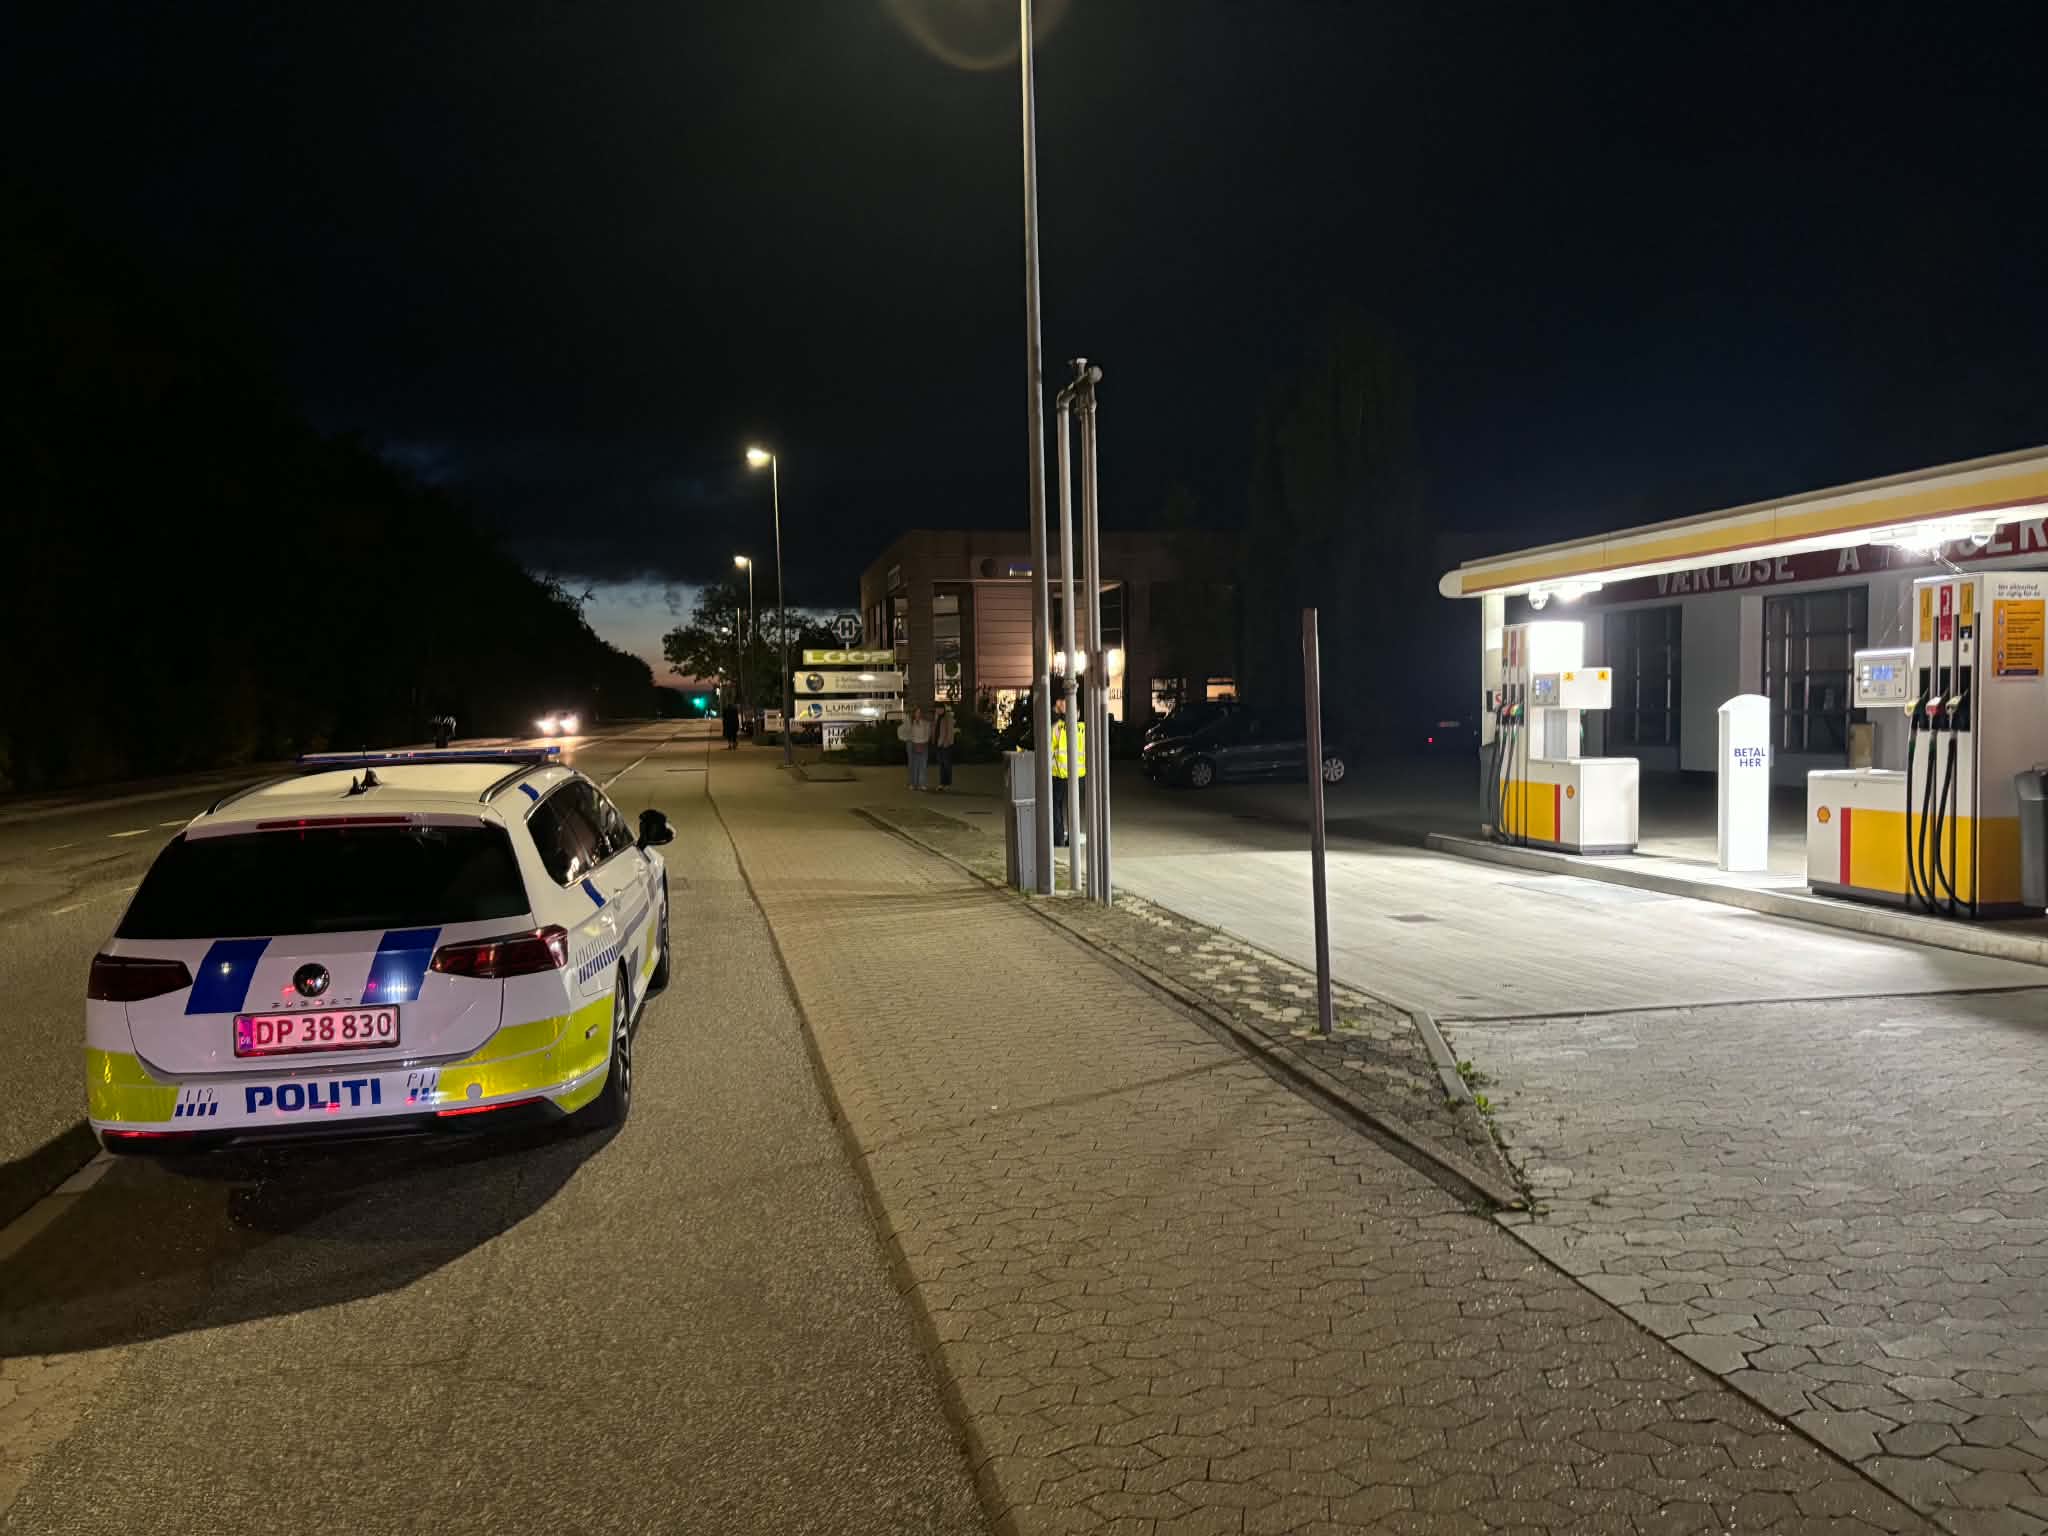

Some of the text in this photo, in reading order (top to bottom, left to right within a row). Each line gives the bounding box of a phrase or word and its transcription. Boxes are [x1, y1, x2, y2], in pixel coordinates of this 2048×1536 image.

[1734, 746, 1766, 757] BETAL
[1739, 757, 1761, 767] HER
[256, 1013, 392, 1045] DP 38 830
[245, 1078, 381, 1114] POLITI
